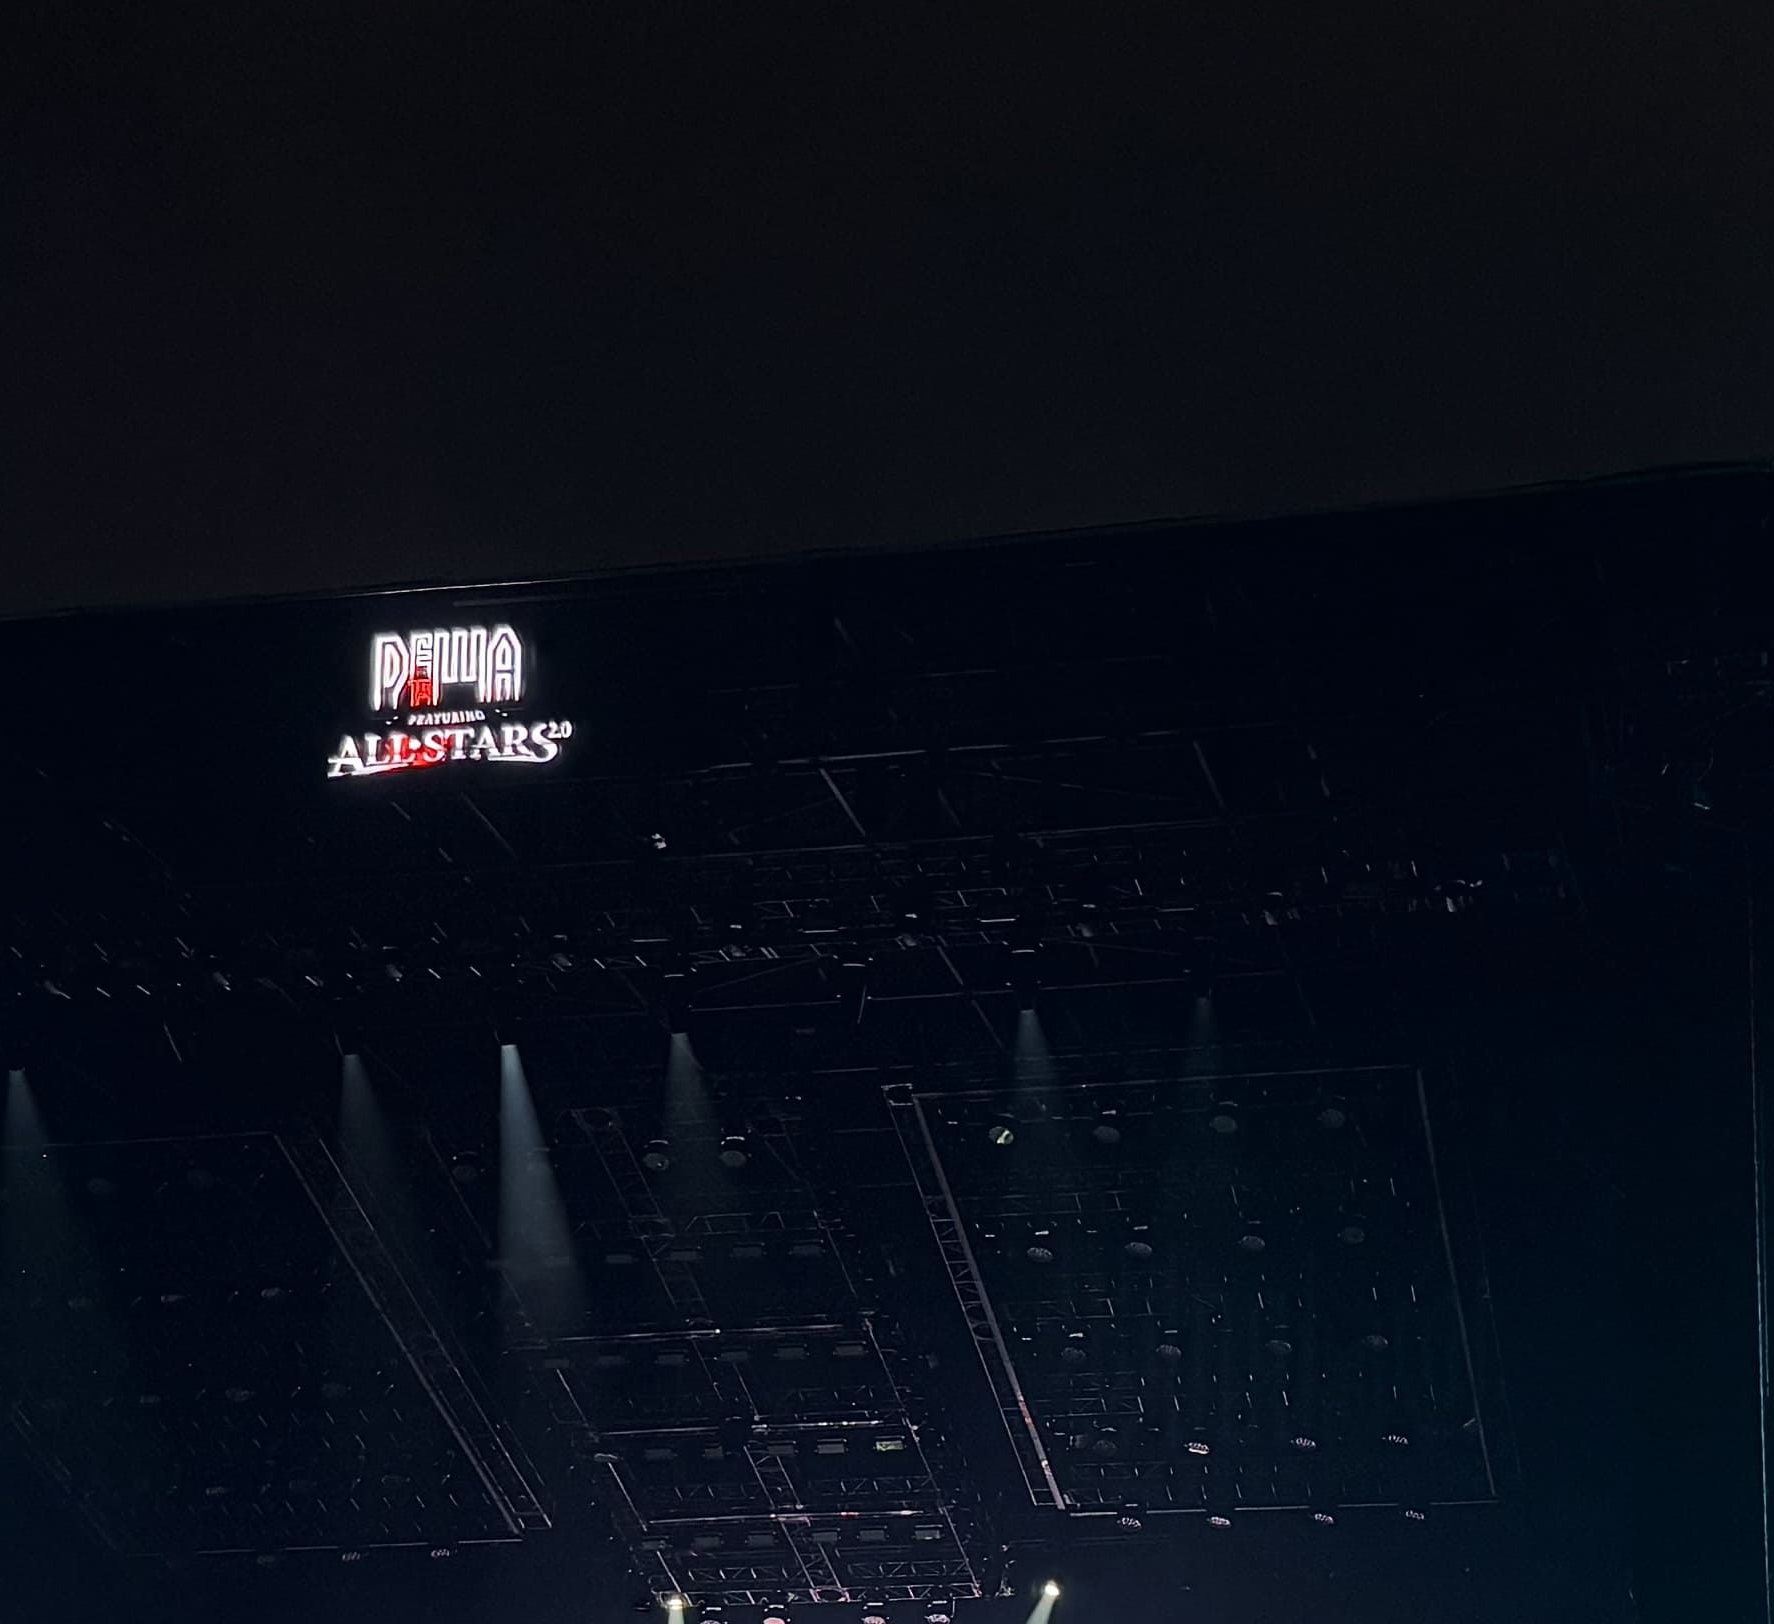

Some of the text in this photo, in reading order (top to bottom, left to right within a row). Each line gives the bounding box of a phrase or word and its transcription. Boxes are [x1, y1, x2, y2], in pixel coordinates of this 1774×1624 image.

[374, 624, 522, 710] DEWA
[327, 732, 413, 778] ALL
[422, 721, 561, 763] STARS
